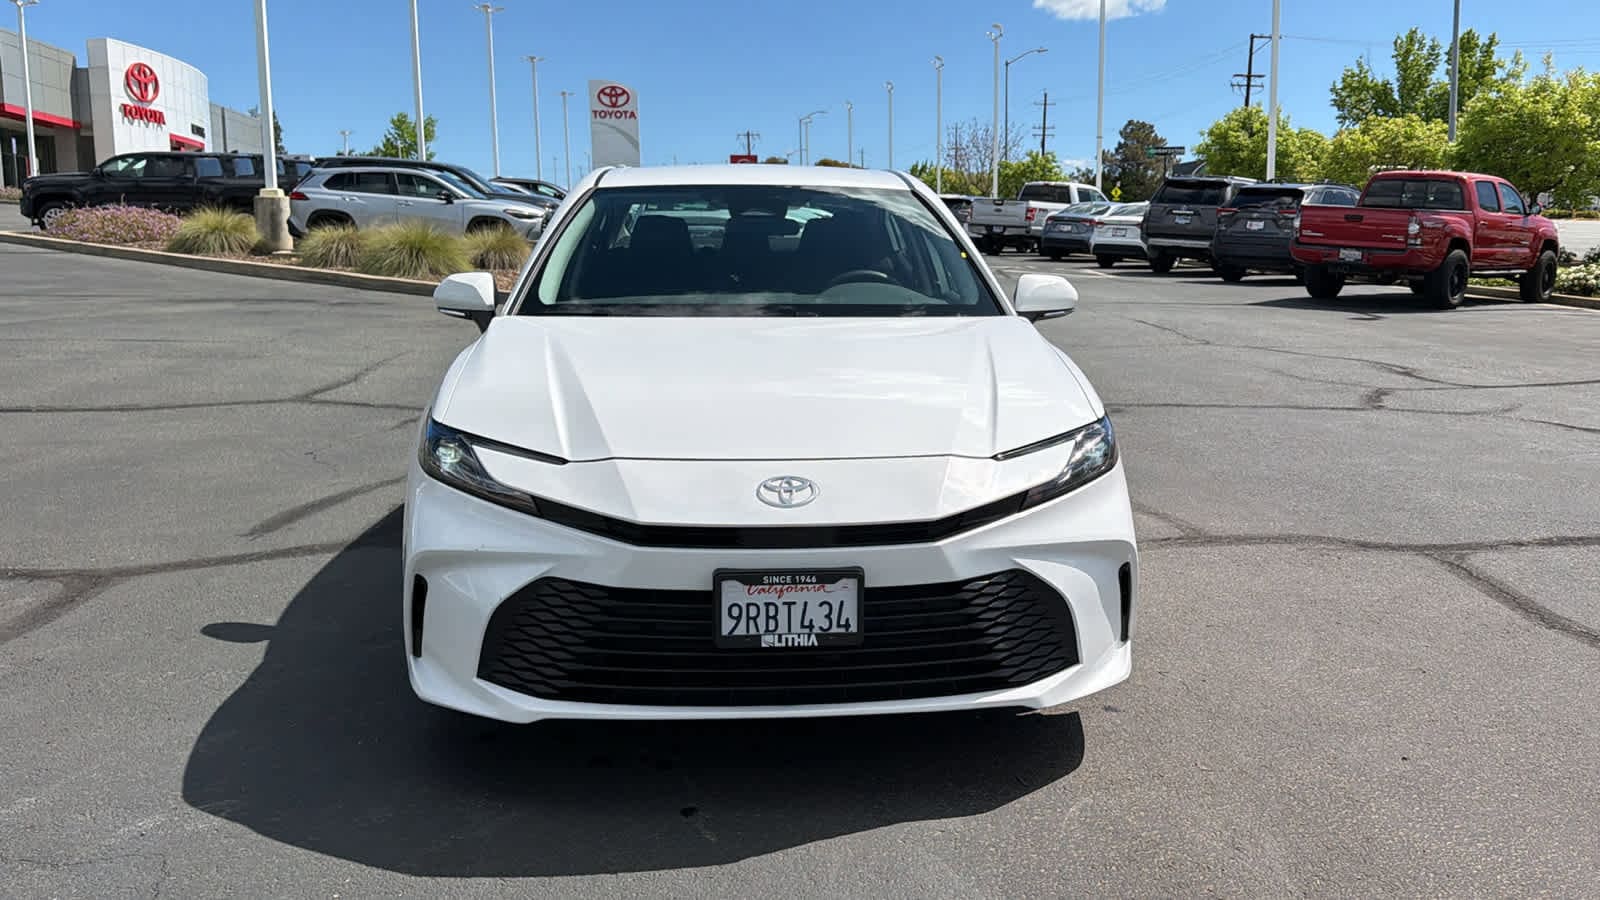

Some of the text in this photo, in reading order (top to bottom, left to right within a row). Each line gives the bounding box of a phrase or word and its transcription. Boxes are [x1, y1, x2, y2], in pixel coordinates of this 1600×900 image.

[121, 103, 166, 125] TOYOTA
[592, 110, 637, 120] TOYOTA
[762, 575, 817, 584] SINCE 1946
[747, 583, 834, 599] California
[727, 600, 851, 635] 9RBT434
[774, 634, 818, 647] LITHIA
